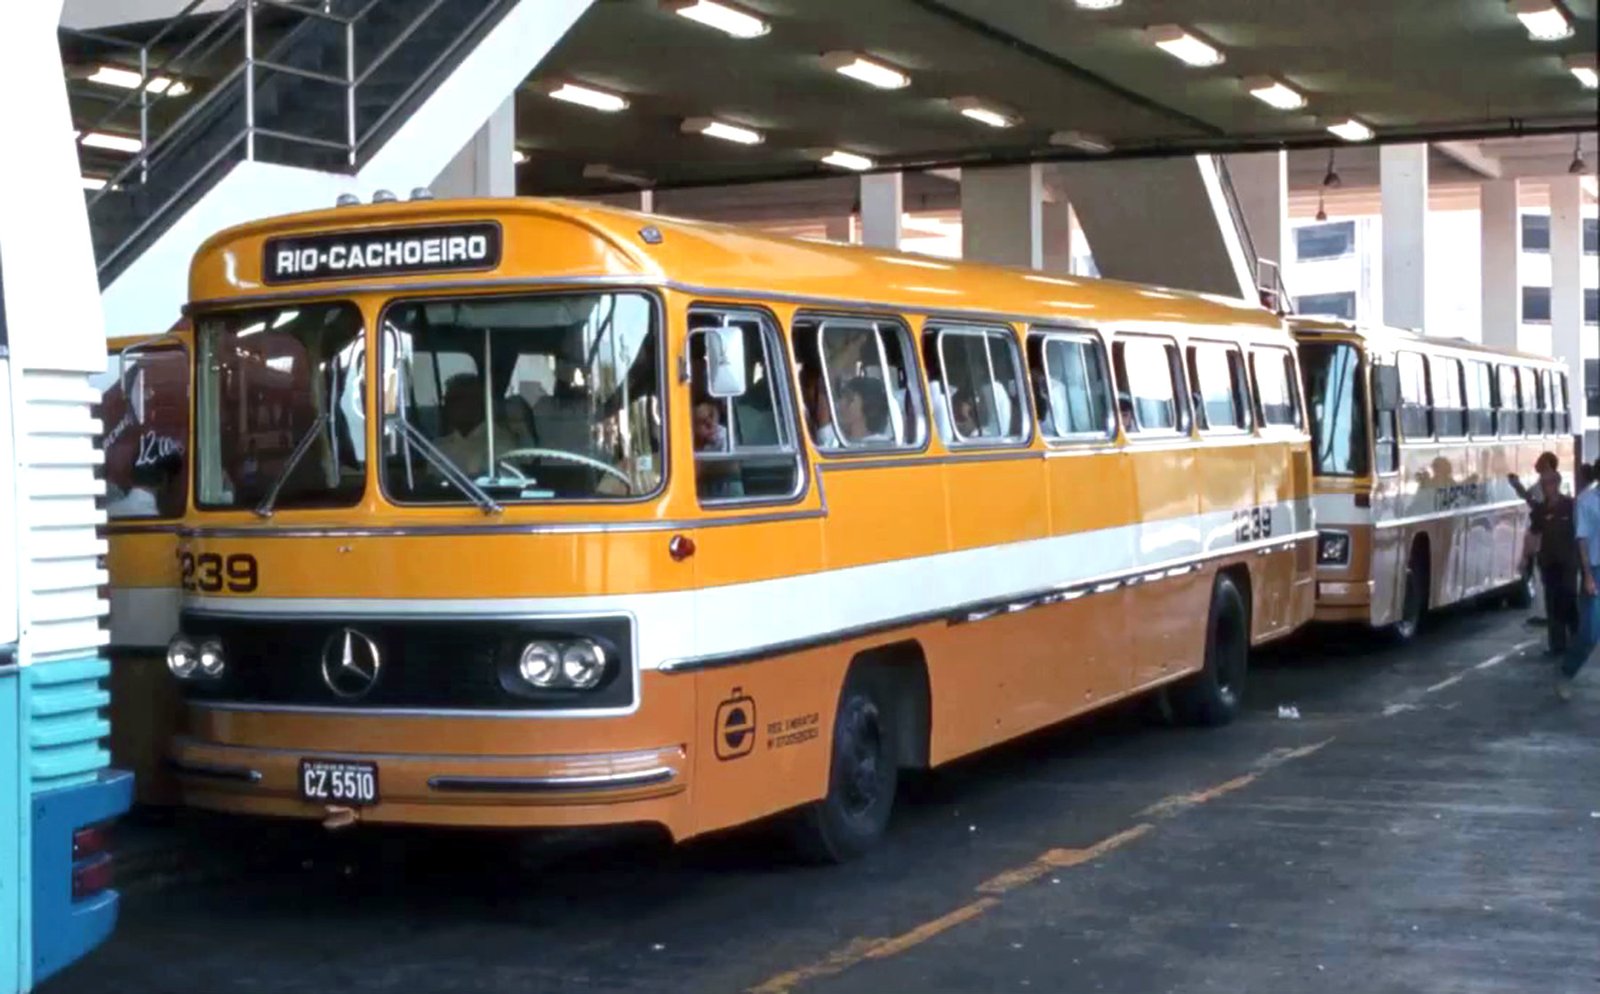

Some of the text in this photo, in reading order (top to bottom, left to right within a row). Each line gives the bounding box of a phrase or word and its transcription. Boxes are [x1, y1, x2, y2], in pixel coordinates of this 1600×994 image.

[1232, 507, 1272, 543] 1239
[304, 769, 375, 800] CZ 5510
